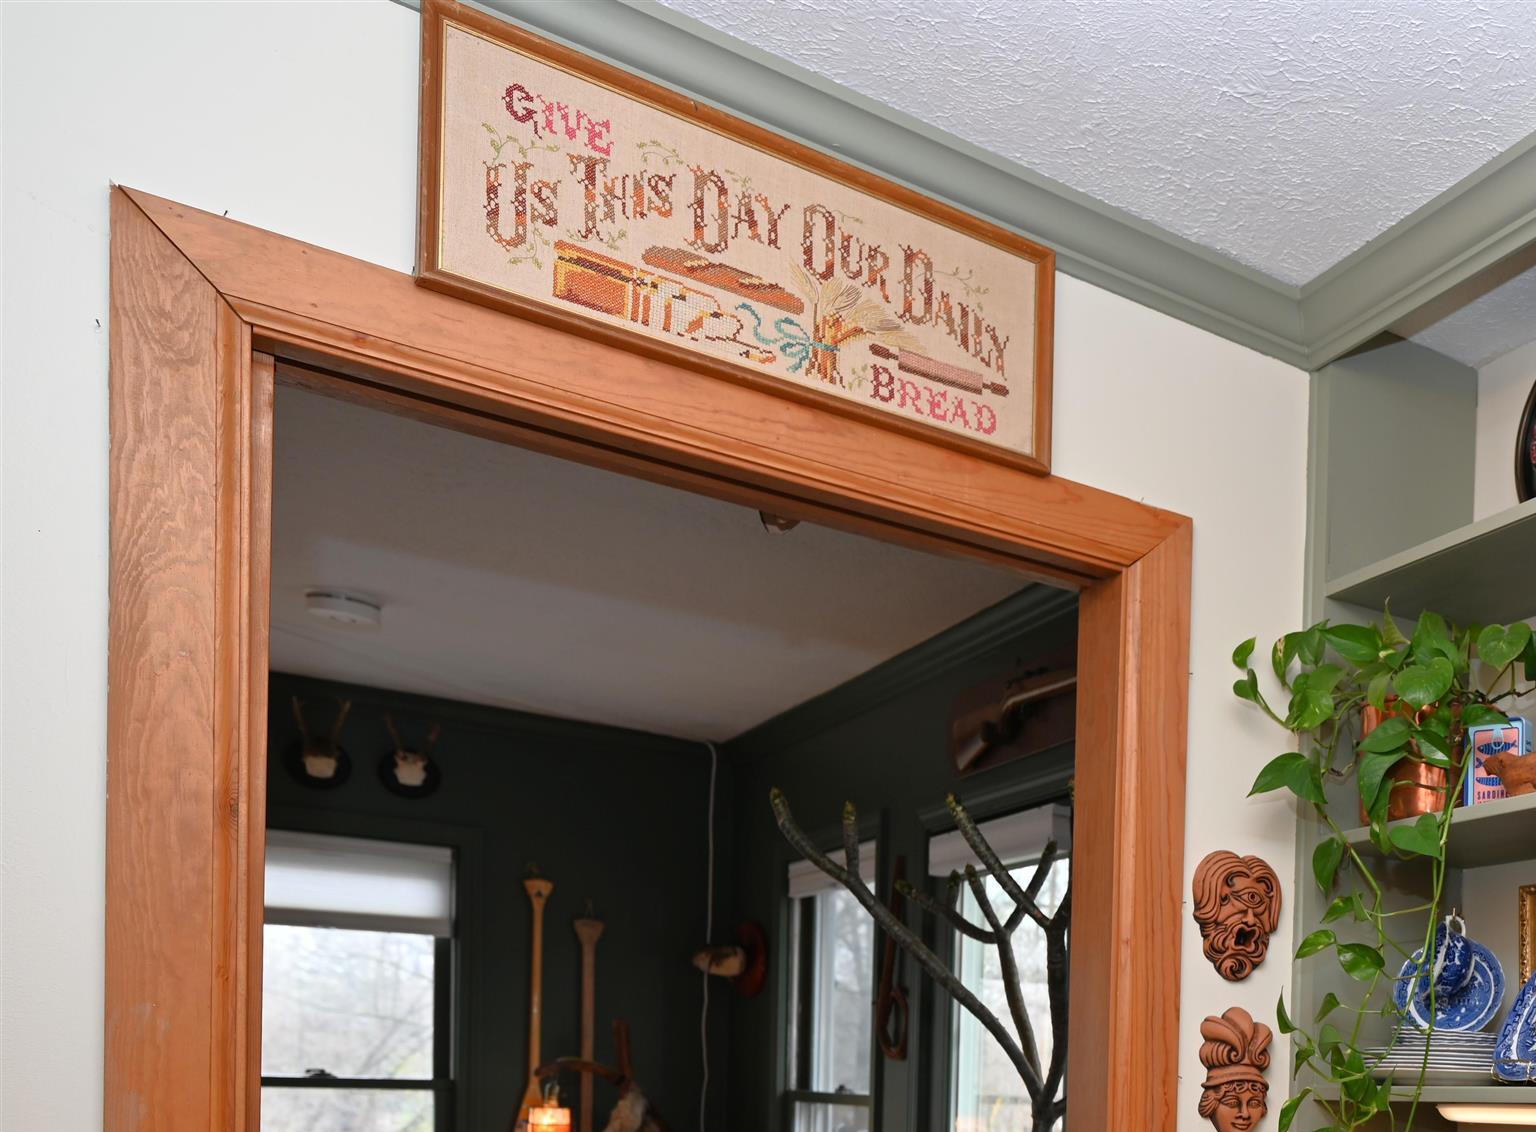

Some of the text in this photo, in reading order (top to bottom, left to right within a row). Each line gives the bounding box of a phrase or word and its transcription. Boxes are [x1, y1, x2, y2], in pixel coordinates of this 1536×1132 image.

[502, 82, 612, 159] GIVE
[482, 152, 1011, 381] US THIS DAY OUR DAILY
[869, 362, 997, 436] BREAD
